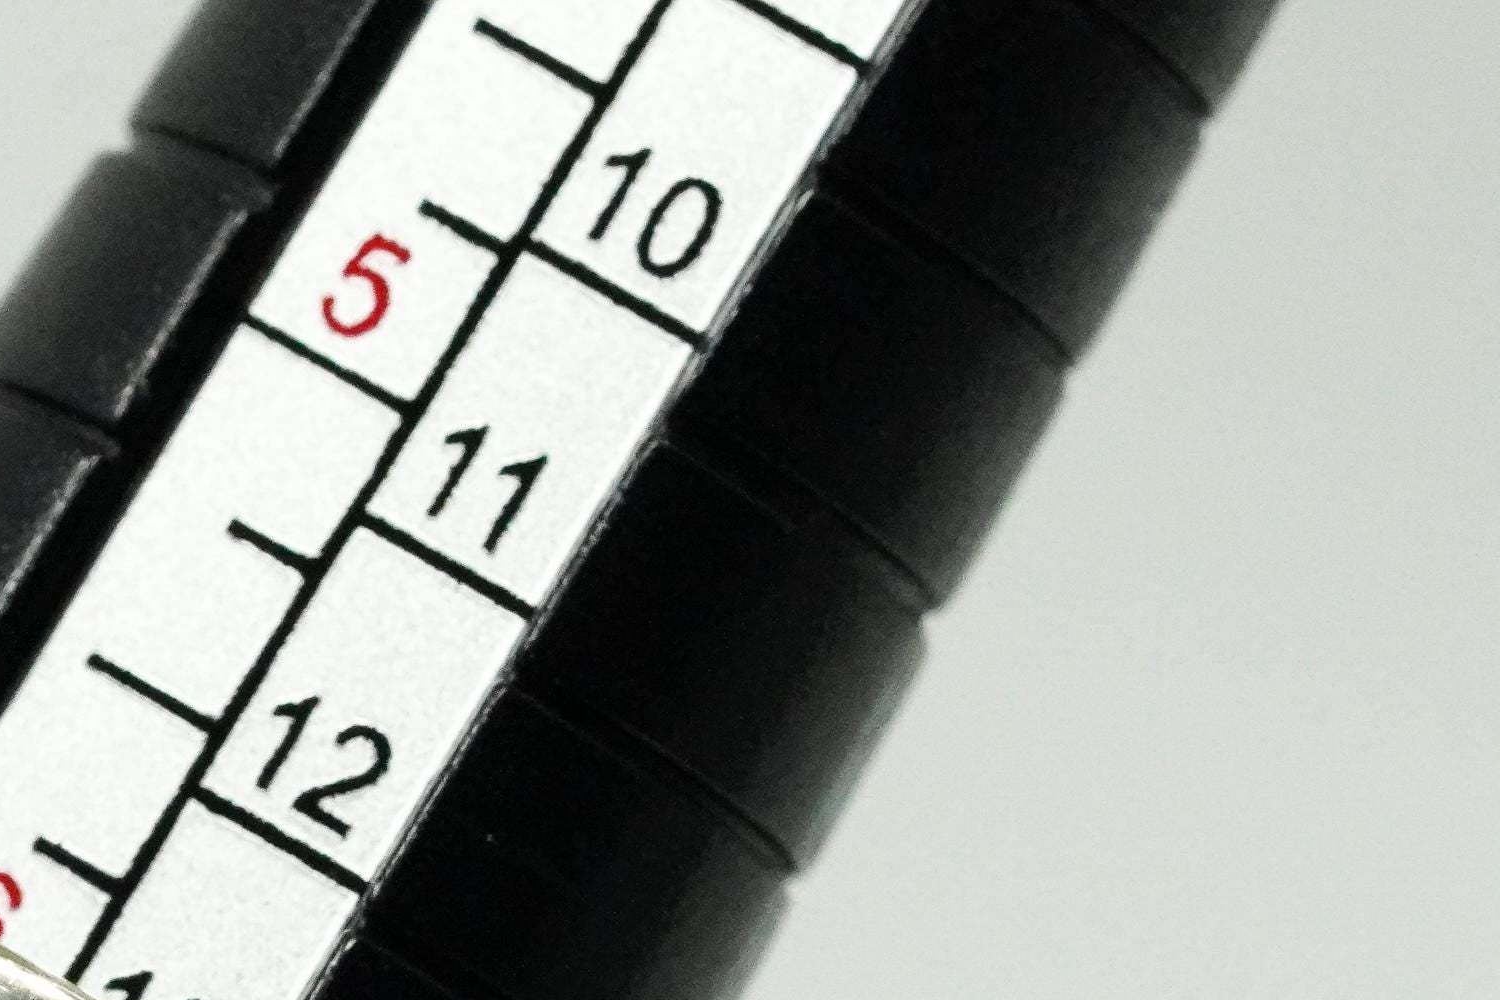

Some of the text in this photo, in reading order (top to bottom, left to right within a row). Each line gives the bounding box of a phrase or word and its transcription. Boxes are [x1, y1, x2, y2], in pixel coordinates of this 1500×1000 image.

[587, 147, 724, 280] 10
[322, 233, 412, 338] 5
[426, 425, 549, 554] 11
[255, 695, 393, 839] 12
